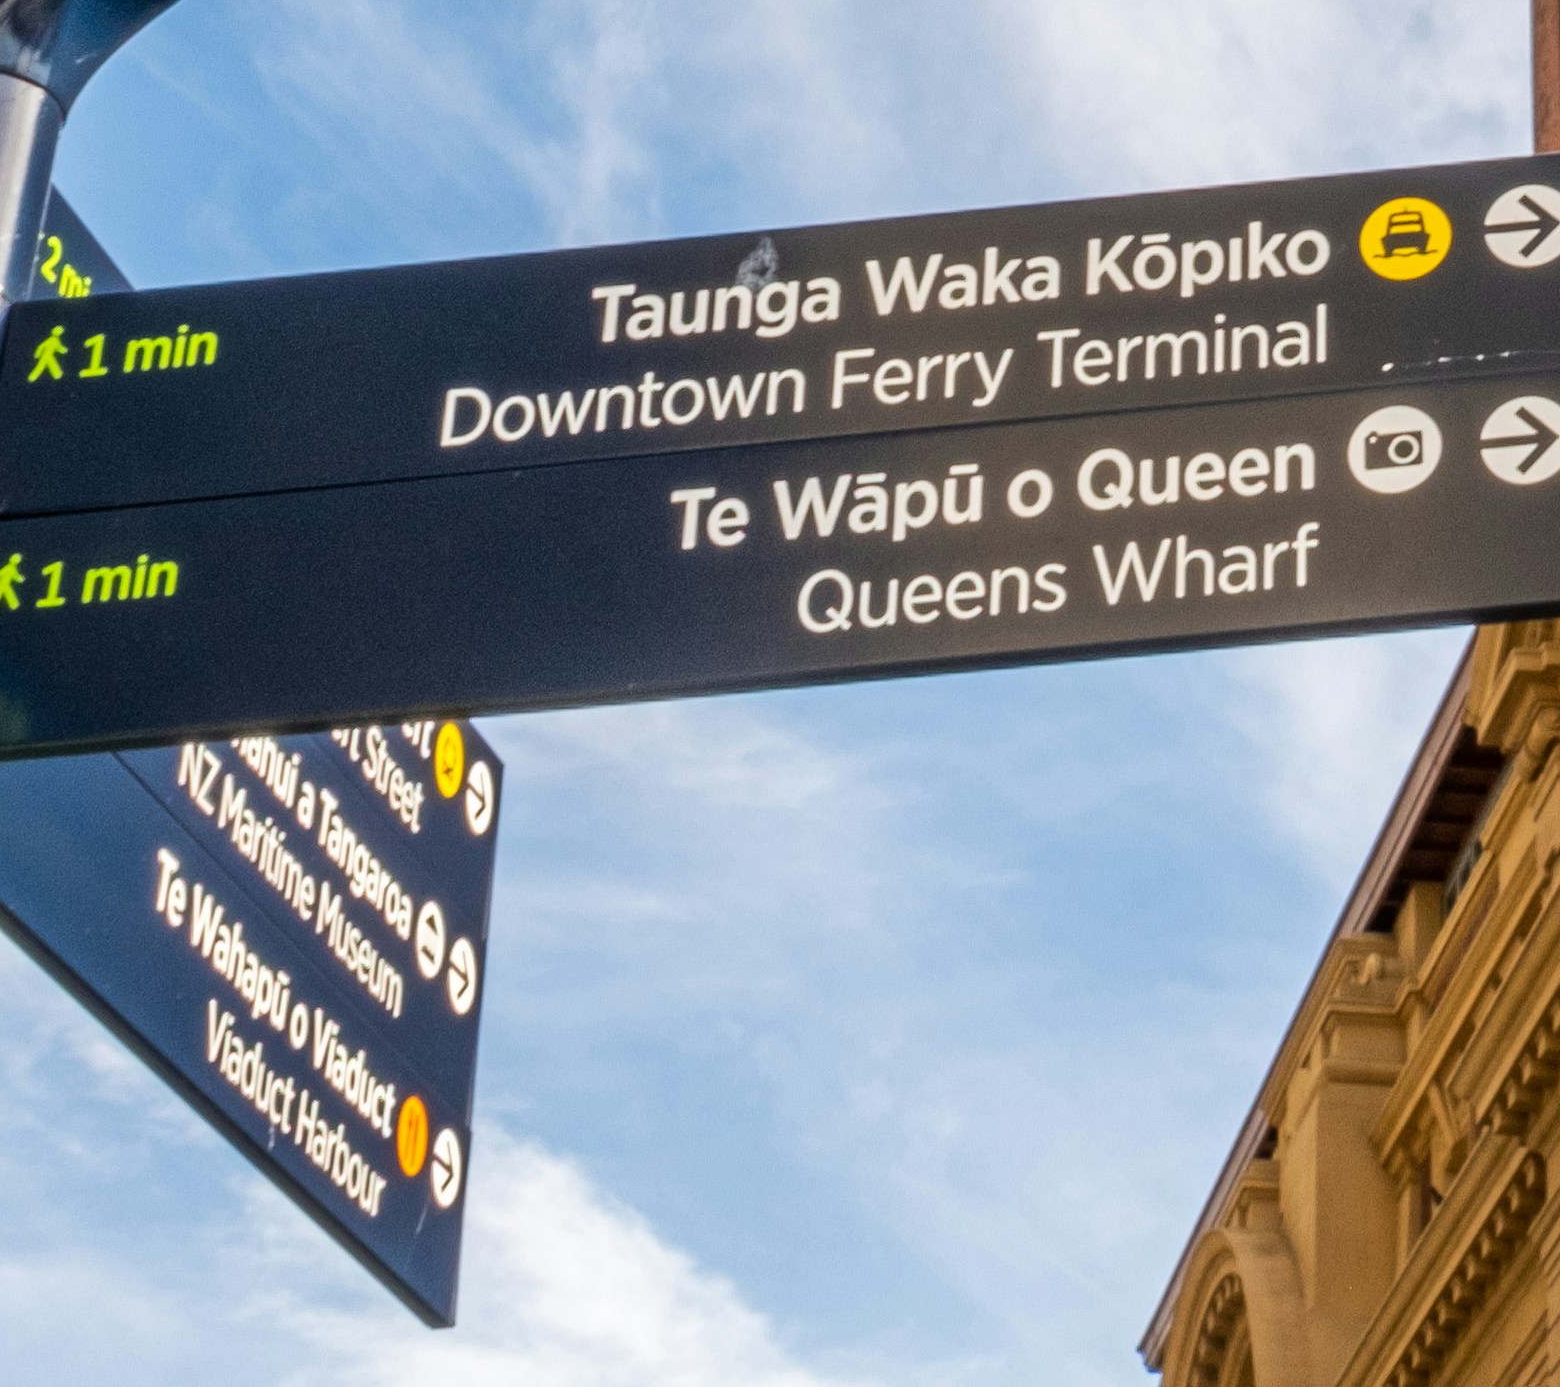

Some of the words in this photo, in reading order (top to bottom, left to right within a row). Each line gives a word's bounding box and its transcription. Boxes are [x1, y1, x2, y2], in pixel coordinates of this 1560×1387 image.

[592, 277, 841, 342] Taunga
[866, 247, 1060, 315] Waka
[80, 335, 107, 377] 1
[124, 325, 217, 372] min
[440, 369, 805, 447] Downtown
[832, 348, 1013, 409] Ferry
[1037, 303, 1327, 388] Terminal
[671, 487, 749, 550] Te
[773, 464, 983, 542] Wāpū
[1007, 469, 1053, 518] o
[1077, 443, 1315, 510] Queen
[36, 562, 64, 608] 1
[82, 555, 178, 603] min
[798, 563, 1067, 633] Queens
[1093, 522, 1319, 605] Wharf
[362, 725, 425, 834] Street
[178, 742, 222, 816] NZ
[217, 774, 315, 920] Maritime
[315, 881, 403, 1018] Museum
[297, 781, 315, 829] a
[318, 788, 413, 940] Tangaroa
[156, 847, 187, 927] Te
[190, 883, 290, 1031] Wahapū
[290, 1003, 309, 1049] o
[314, 1008, 396, 1138] Viaduct
[208, 998, 296, 1134] Viaduct
[295, 1089, 386, 1217] Harbour
